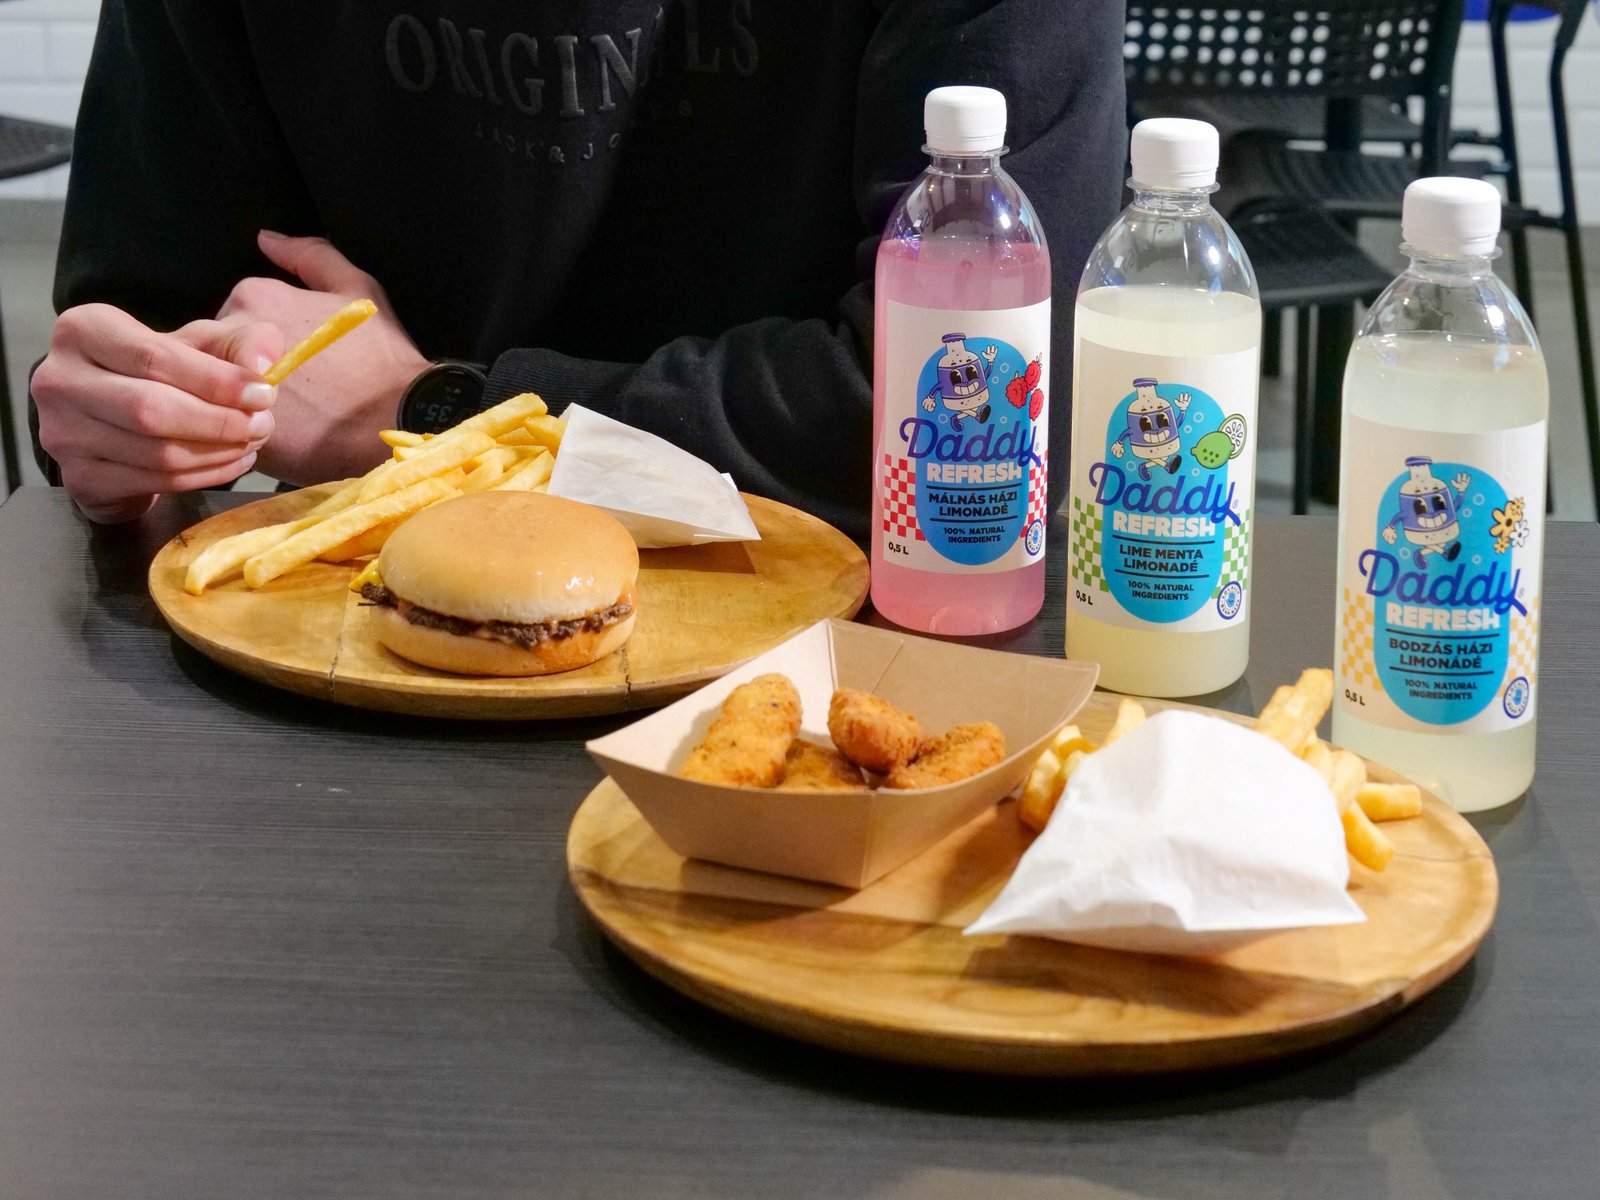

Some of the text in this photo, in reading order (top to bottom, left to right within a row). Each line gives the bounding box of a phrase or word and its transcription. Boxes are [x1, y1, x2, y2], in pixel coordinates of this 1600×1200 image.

[899, 417, 1041, 468] Daddy
[926, 462, 1022, 484] REFRESH
[929, 490, 1018, 505] MÁLNÁS HÁZI
[1088, 462, 1241, 527] Daddy
[944, 526, 1006, 535] 100% NATURAL
[1112, 510, 1216, 538] REFRESH
[948, 535, 1001, 544] INGREDIENTS
[888, 542, 909, 555] 0,5 L
[1119, 543, 1204, 560] LIME MENTA
[1128, 580, 1194, 592] 100% NATURAL
[1358, 549, 1528, 617] Daddy
[1075, 589, 1093, 606] 0,5 L
[1131, 589, 1189, 601] INGREDIENTS
[1385, 601, 1501, 632] REFRESH
[1389, 637, 1493, 655] BODZÁS HÁZI
[1404, 677, 1478, 691] 100% NATURAL
[1345, 688, 1366, 707] 0,5 L
[1409, 688, 1473, 701] INGREDIENTS
